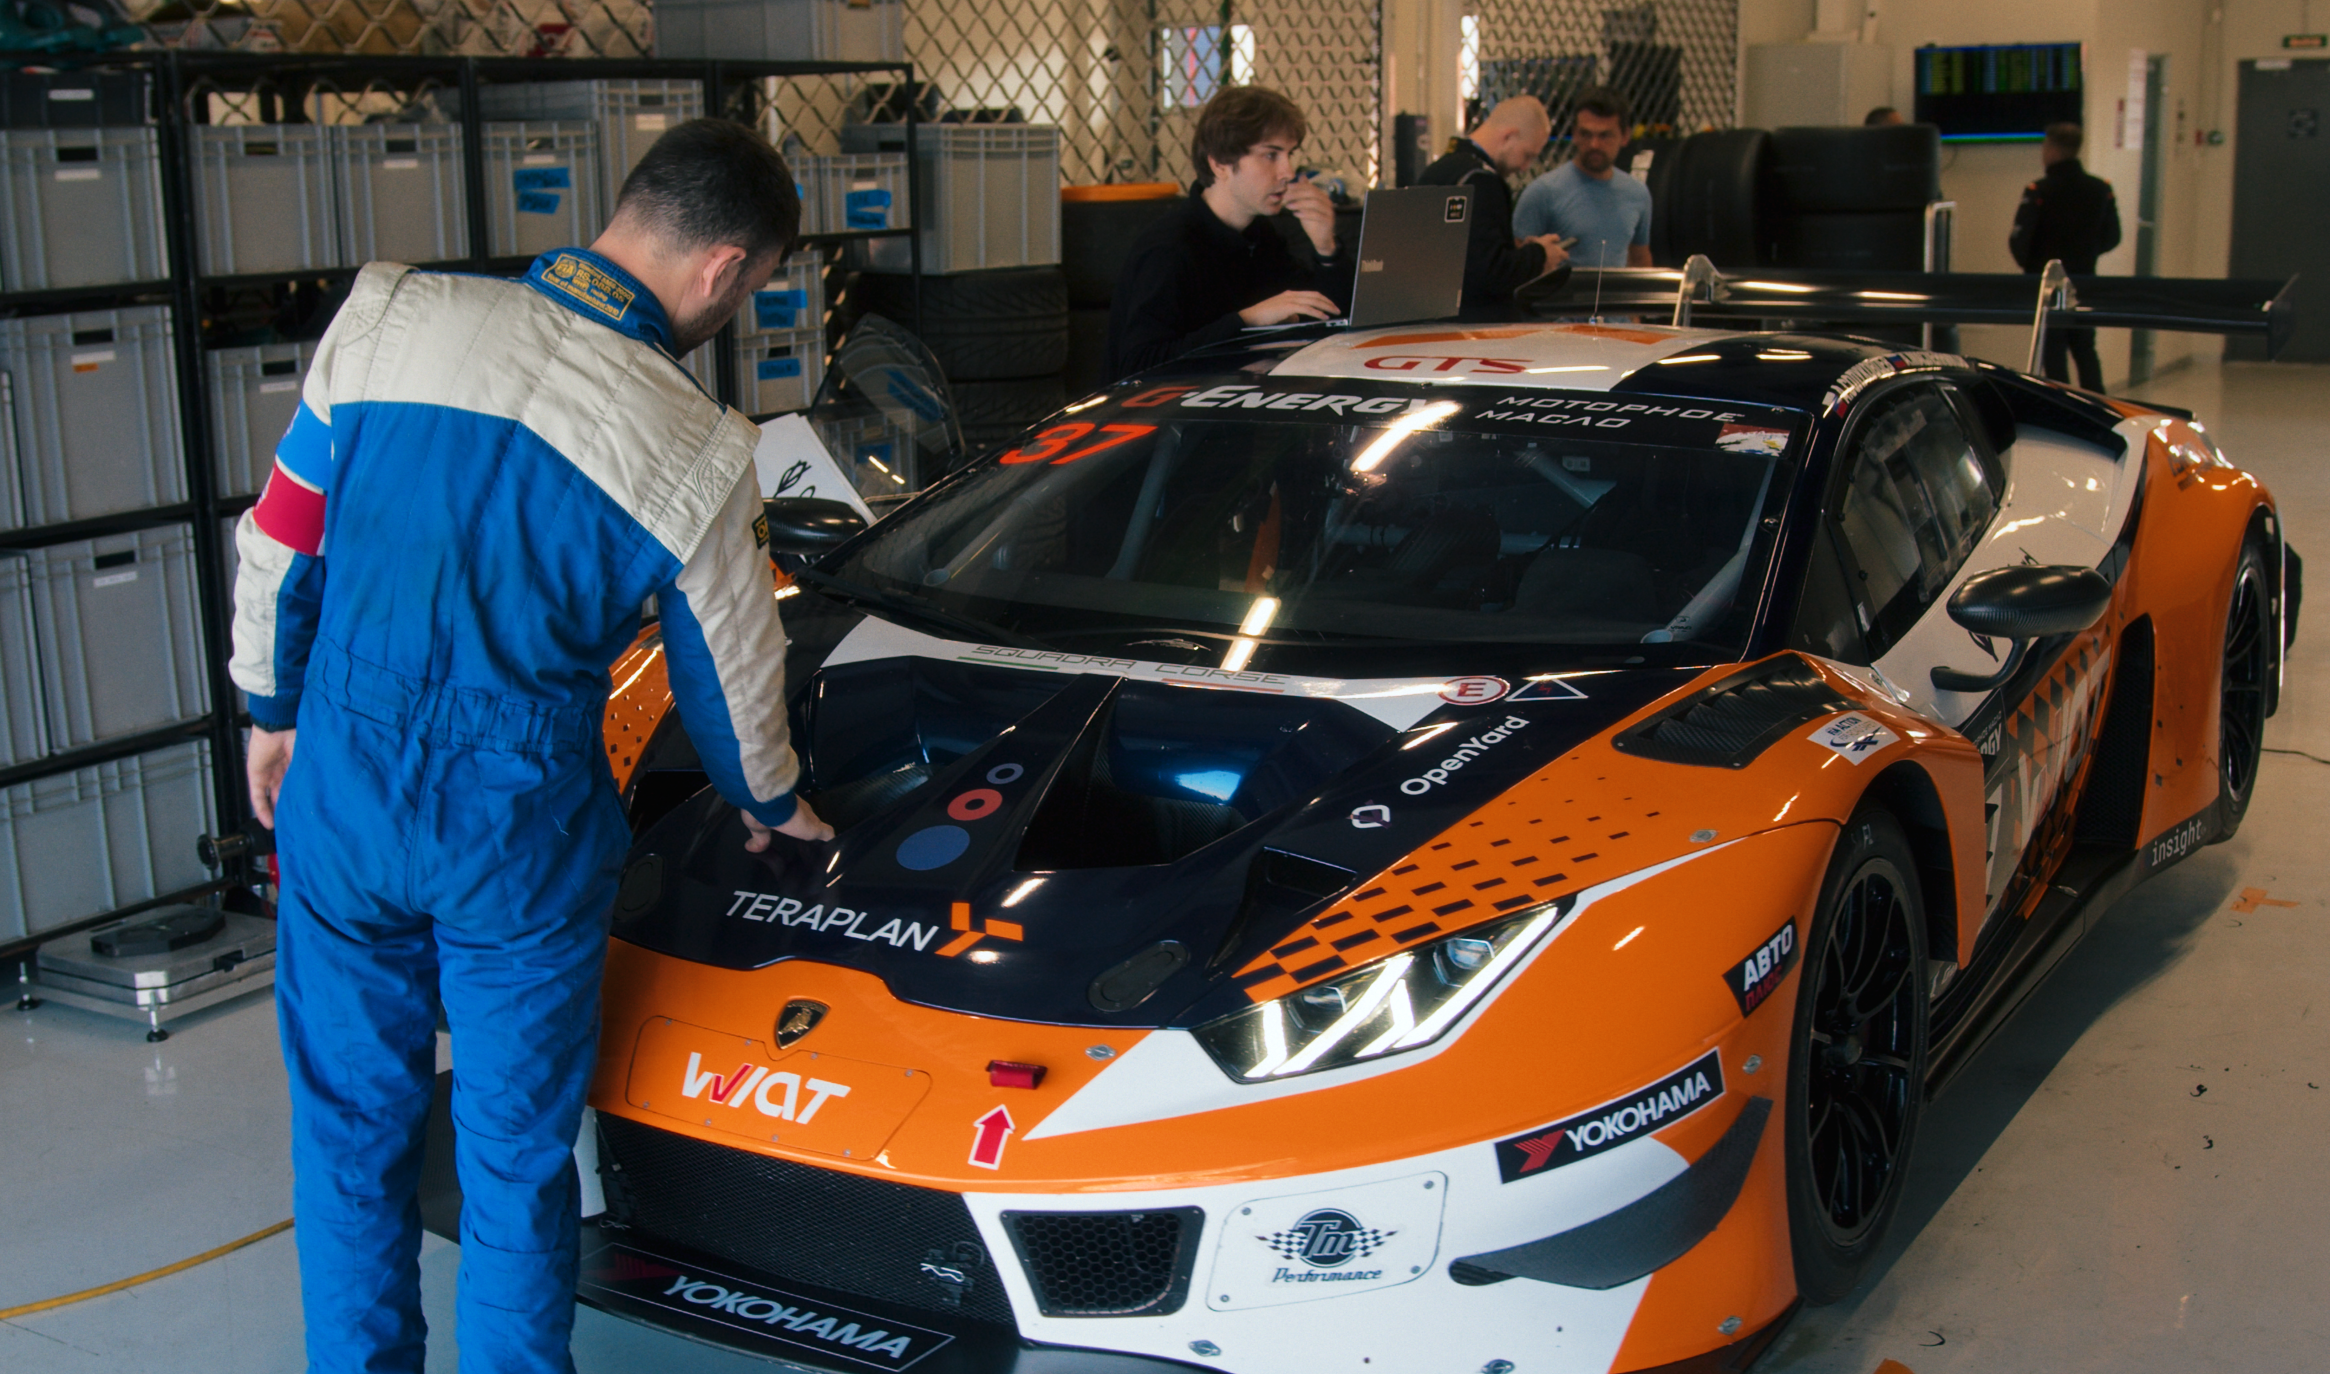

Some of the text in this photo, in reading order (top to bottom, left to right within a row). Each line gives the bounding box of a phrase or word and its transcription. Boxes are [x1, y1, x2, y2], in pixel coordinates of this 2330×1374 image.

[1364, 355, 1535, 374] GTS
[999, 422, 1158, 465] 37
[971, 645, 1291, 686] SQUADRA CORSE
[1457, 682, 1487, 697] E
[1400, 715, 1530, 796] OpenYard
[2151, 818, 2203, 868] insight
[725, 890, 940, 952] TERAPLAN
[1743, 924, 1793, 991] АВТО
[1564, 1070, 1712, 1152] YOKOHAMA
[1271, 1266, 1383, 1284] Performance
[653, 1275, 912, 1359] YOKOHAMA
